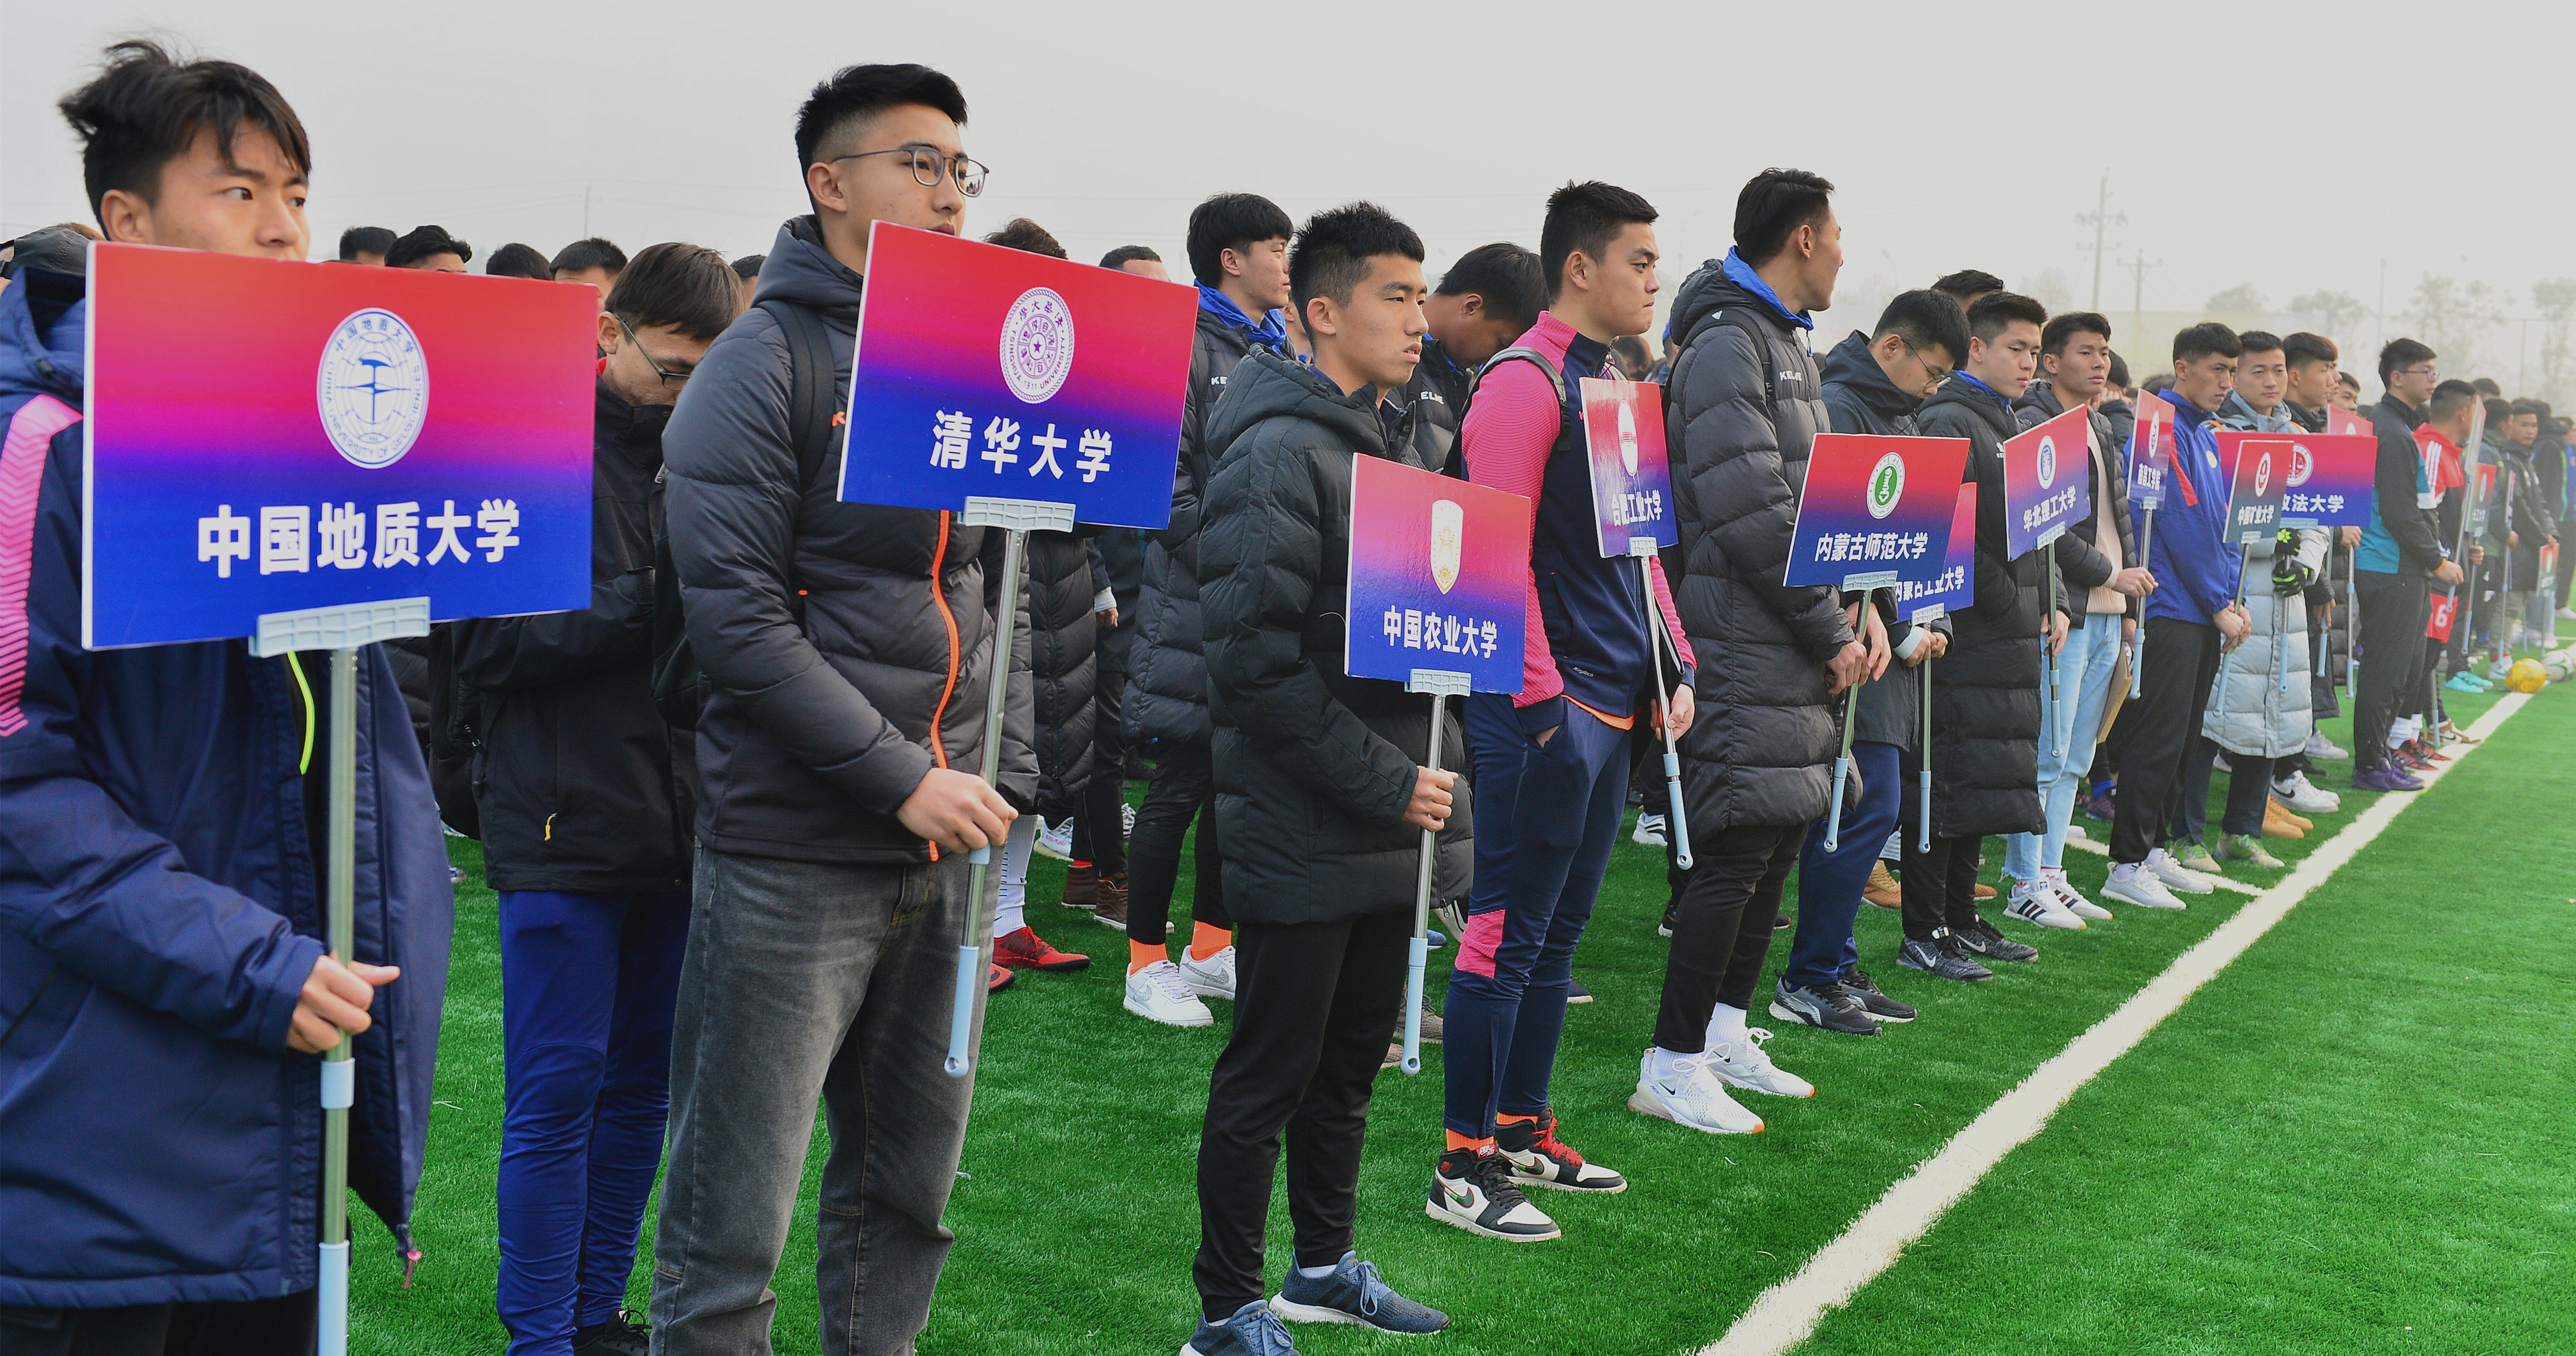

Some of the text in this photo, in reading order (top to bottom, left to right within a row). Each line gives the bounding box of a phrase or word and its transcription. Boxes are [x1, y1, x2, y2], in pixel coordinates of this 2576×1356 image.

[1039, 337, 1066, 390] UNIVERSITY
[930, 409, 1112, 483] 清华大学
[1611, 489, 1662, 527] 合肥工业大学
[2023, 485, 2076, 532] 华北理工大学
[2237, 504, 2274, 526] 中国矿业大学
[198, 498, 520, 578] 中国地质大学
[1815, 532, 1929, 562] 内蒙古师范大学
[1383, 605, 1497, 659] 中国农业大学
